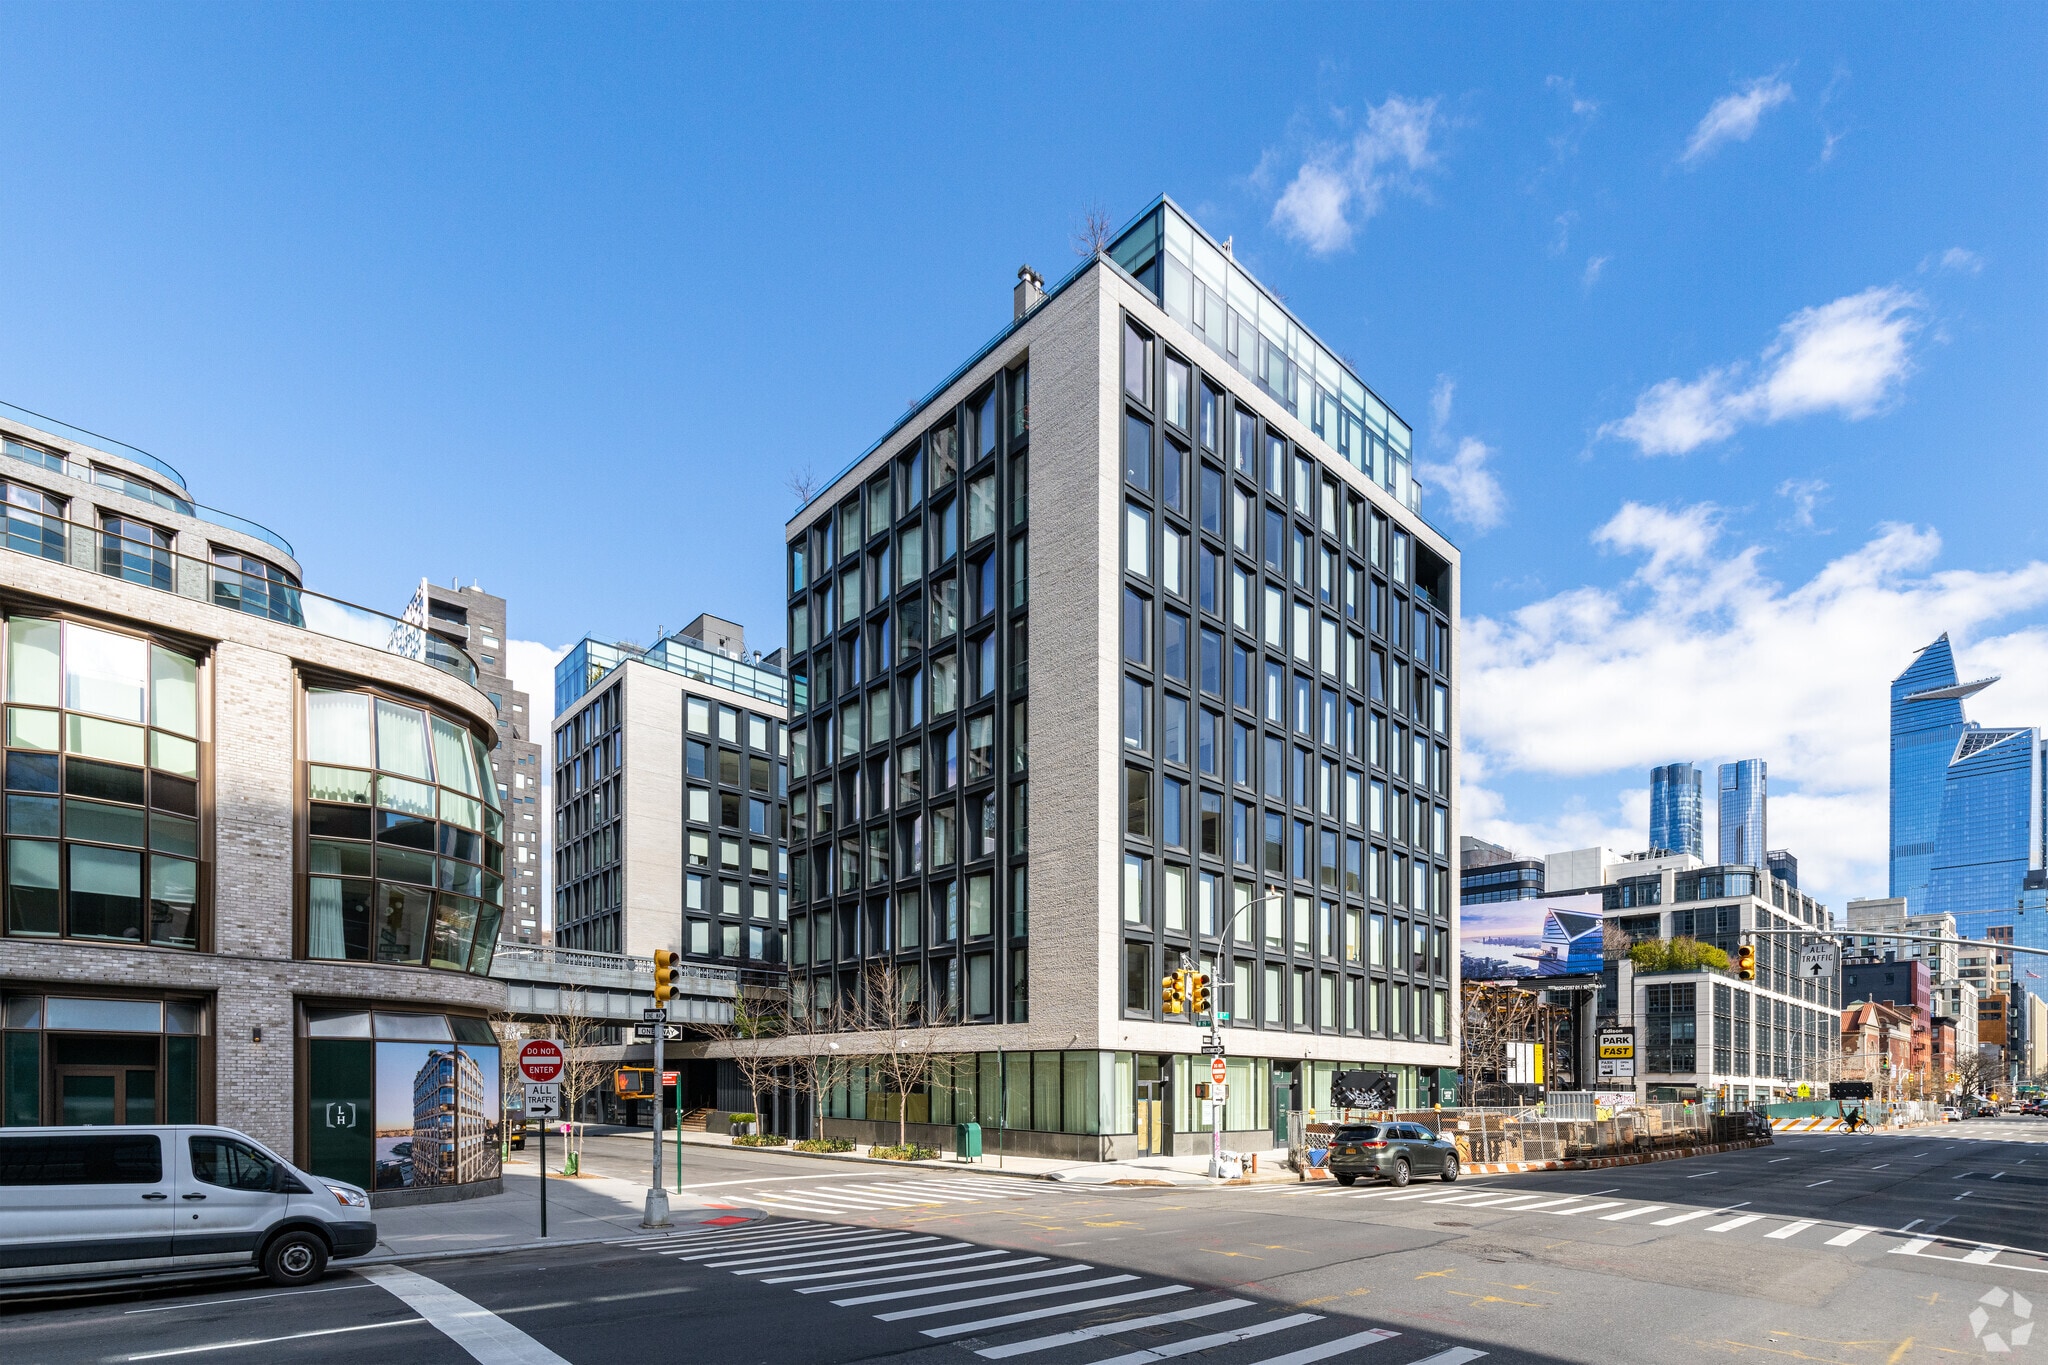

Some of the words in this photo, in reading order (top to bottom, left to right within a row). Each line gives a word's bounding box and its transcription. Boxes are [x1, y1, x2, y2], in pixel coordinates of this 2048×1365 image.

[1802, 954, 1833, 962] TRAFFIC
[532, 1086, 552, 1094] ALL
[338, 1106, 344, 1114] L
[337, 1116, 345, 1124] H
